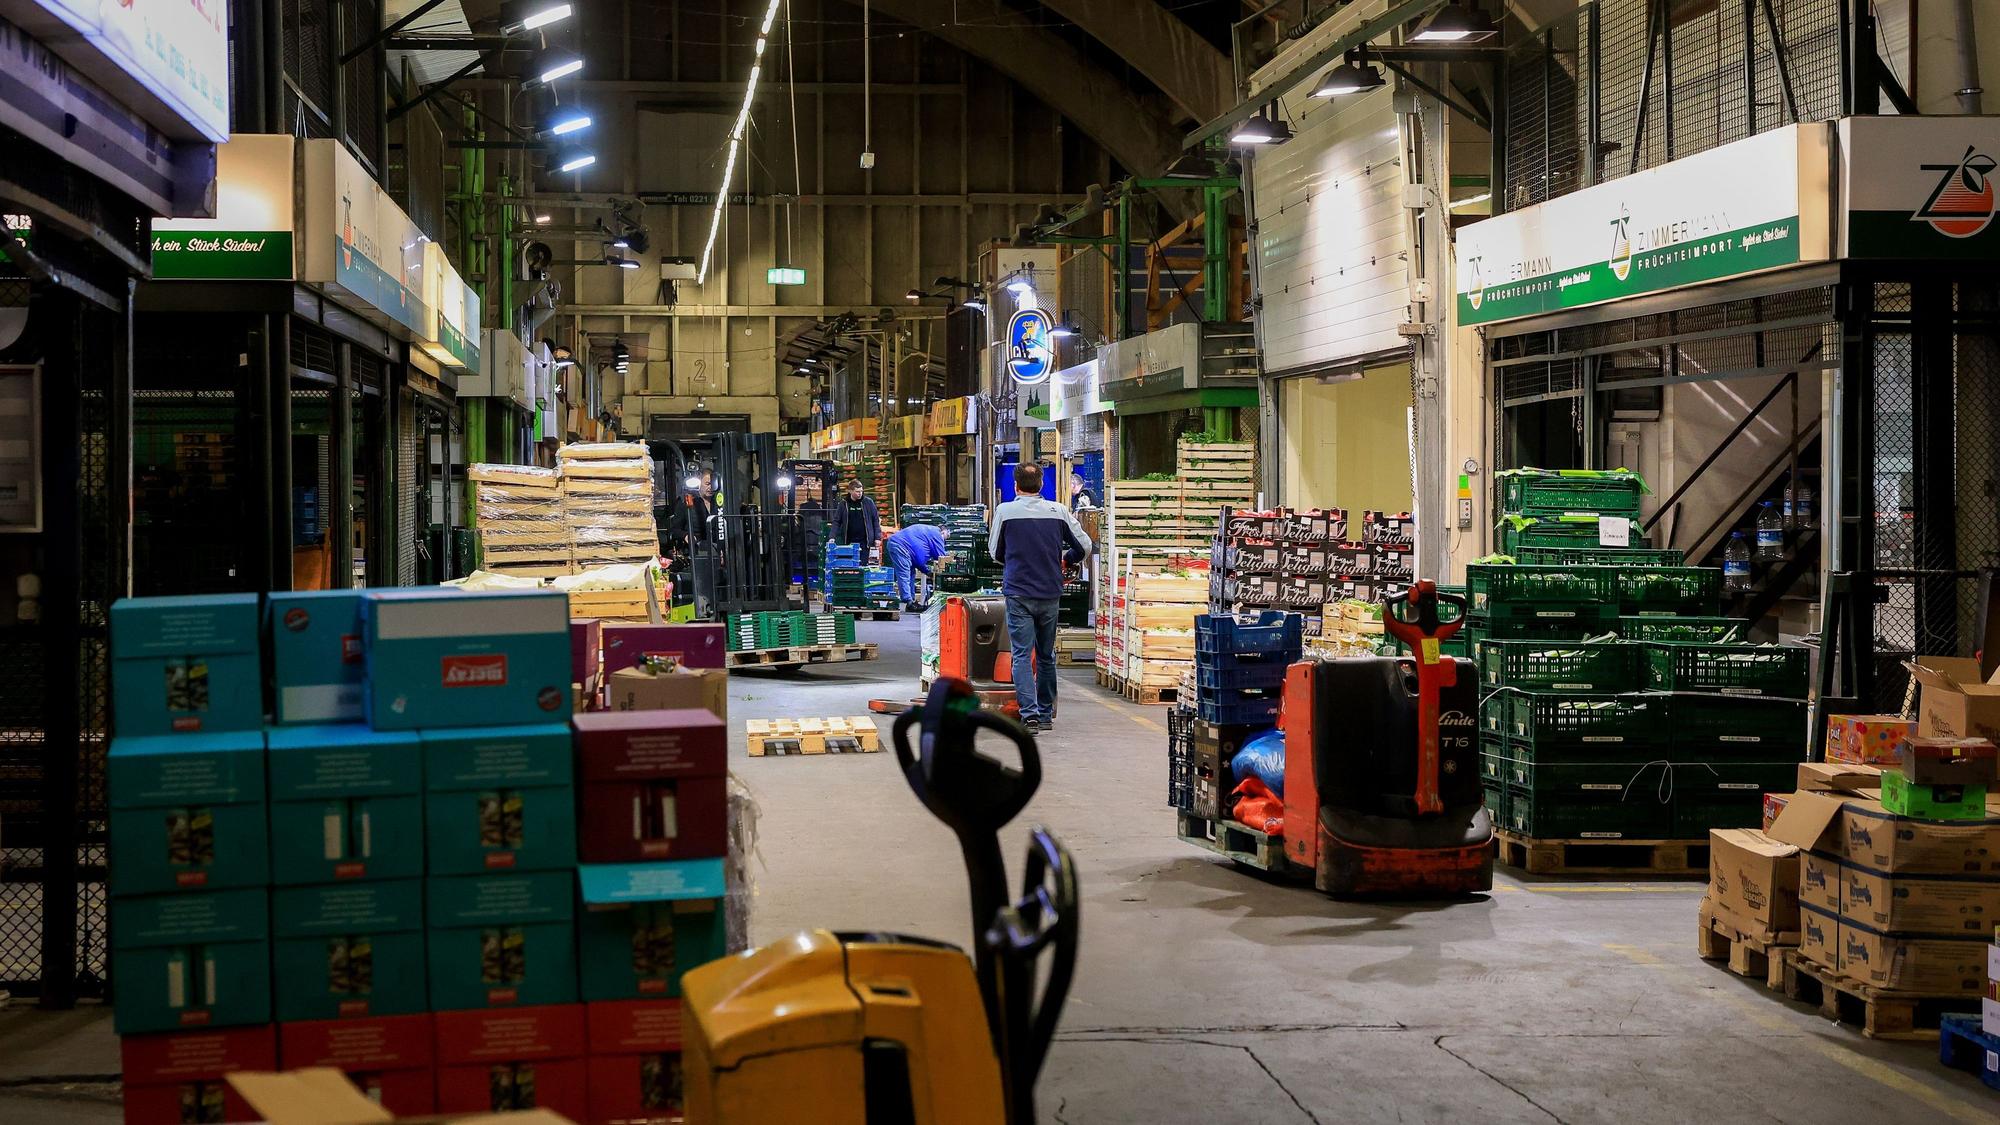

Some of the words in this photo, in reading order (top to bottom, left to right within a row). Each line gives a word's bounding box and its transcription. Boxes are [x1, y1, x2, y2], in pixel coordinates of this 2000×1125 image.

[1638, 211, 1731, 251] ZIMMER
[163, 240, 182, 252] ein
[186, 237, 220, 252] Stück
[221, 238, 266, 252] Süden!
[1638, 238, 1733, 270] FRÜCHTEIMPORT
[1487, 280, 1553, 302] FRÜCHTEIMPORT
[694, 359, 707, 382] 2
[717, 507, 725, 540] CLARK
[1438, 711, 1475, 726] Linde
[1442, 737, 1453, 749] T
[1455, 737, 1470, 748] 16
